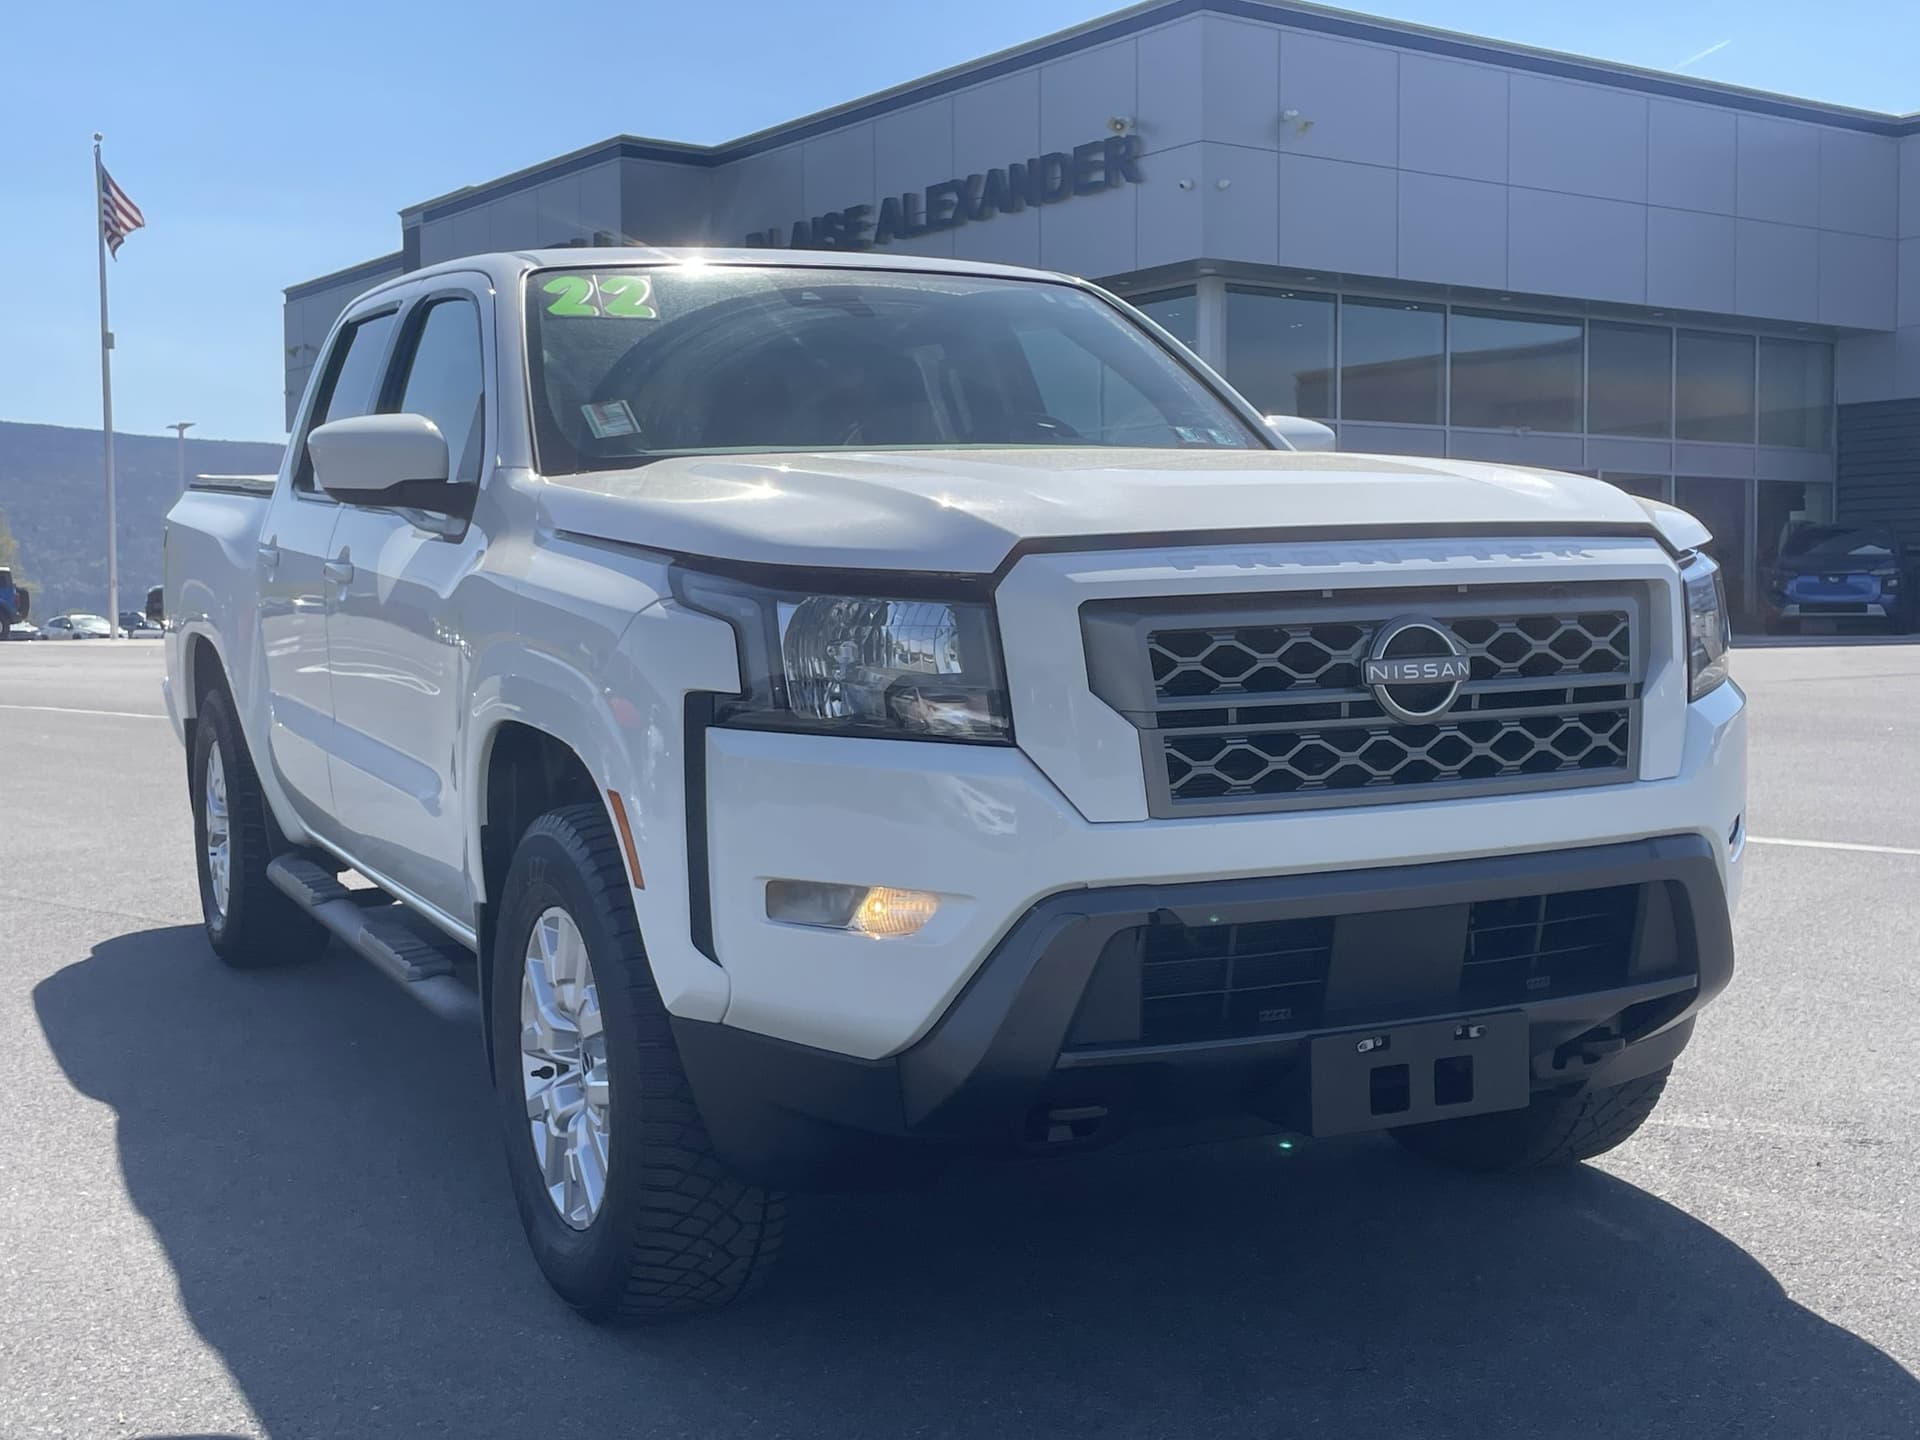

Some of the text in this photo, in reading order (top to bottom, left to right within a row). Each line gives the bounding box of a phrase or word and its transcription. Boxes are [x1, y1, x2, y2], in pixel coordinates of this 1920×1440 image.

[874, 134, 1145, 244] ALEXANDER
[543, 275, 656, 318] 22
[1166, 543, 1593, 571] FRONTIER
[1369, 661, 1470, 681] NISSAN
